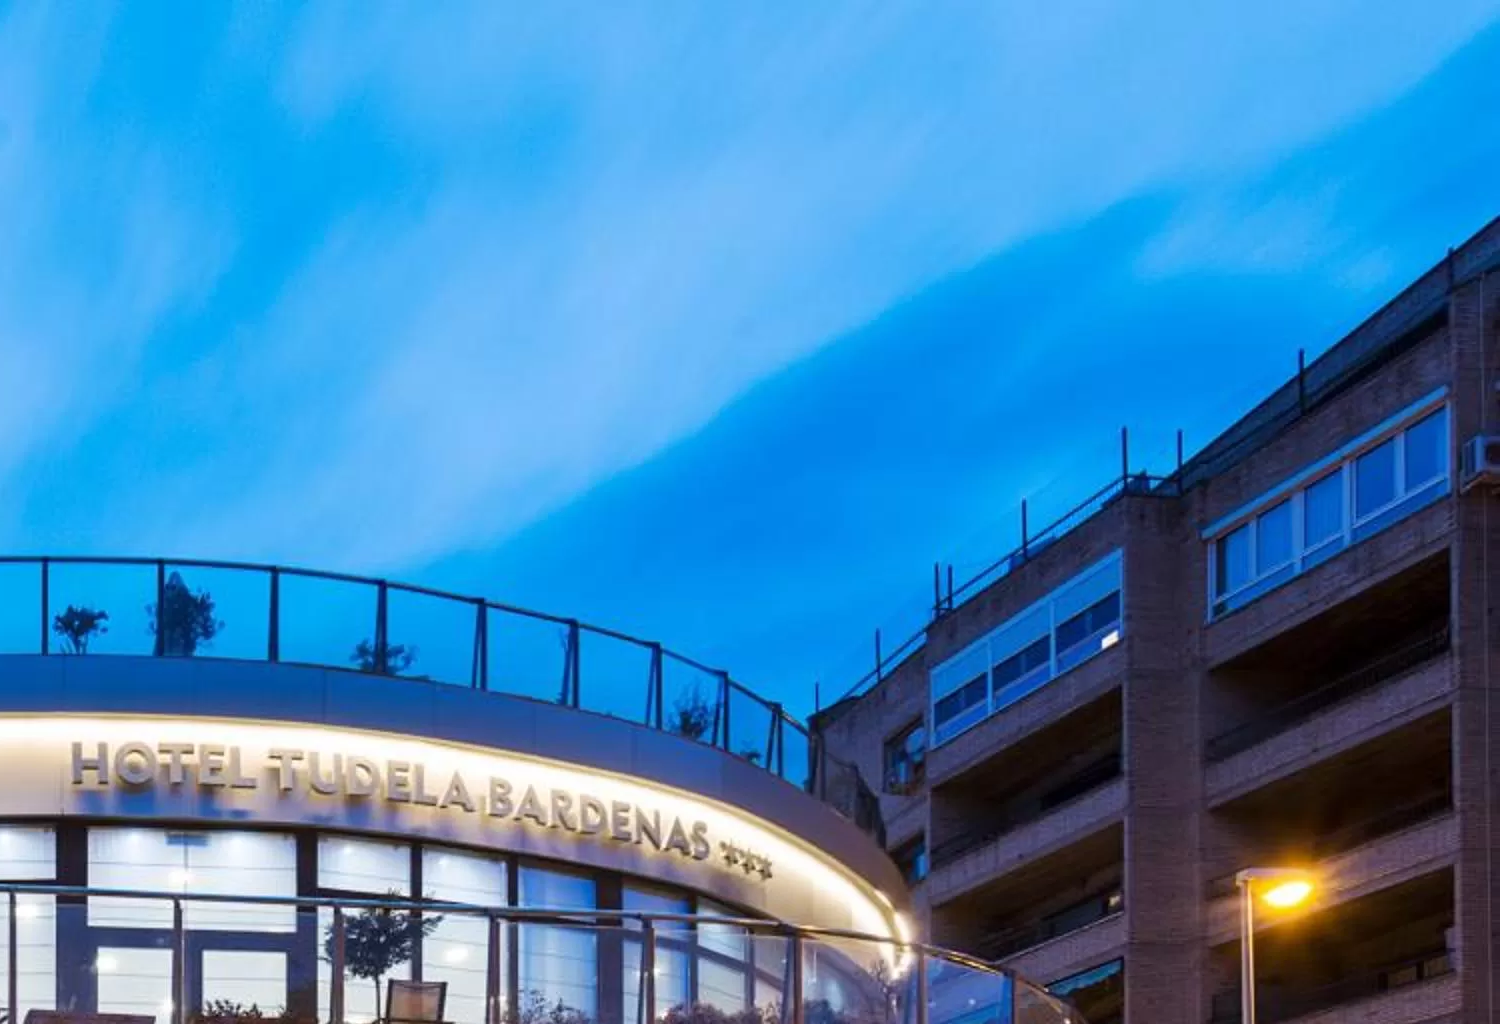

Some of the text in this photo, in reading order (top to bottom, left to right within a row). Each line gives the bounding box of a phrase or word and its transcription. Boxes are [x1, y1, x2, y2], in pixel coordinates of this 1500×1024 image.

[71, 740, 711, 861] HOTEL TUDELA BARDENAS
